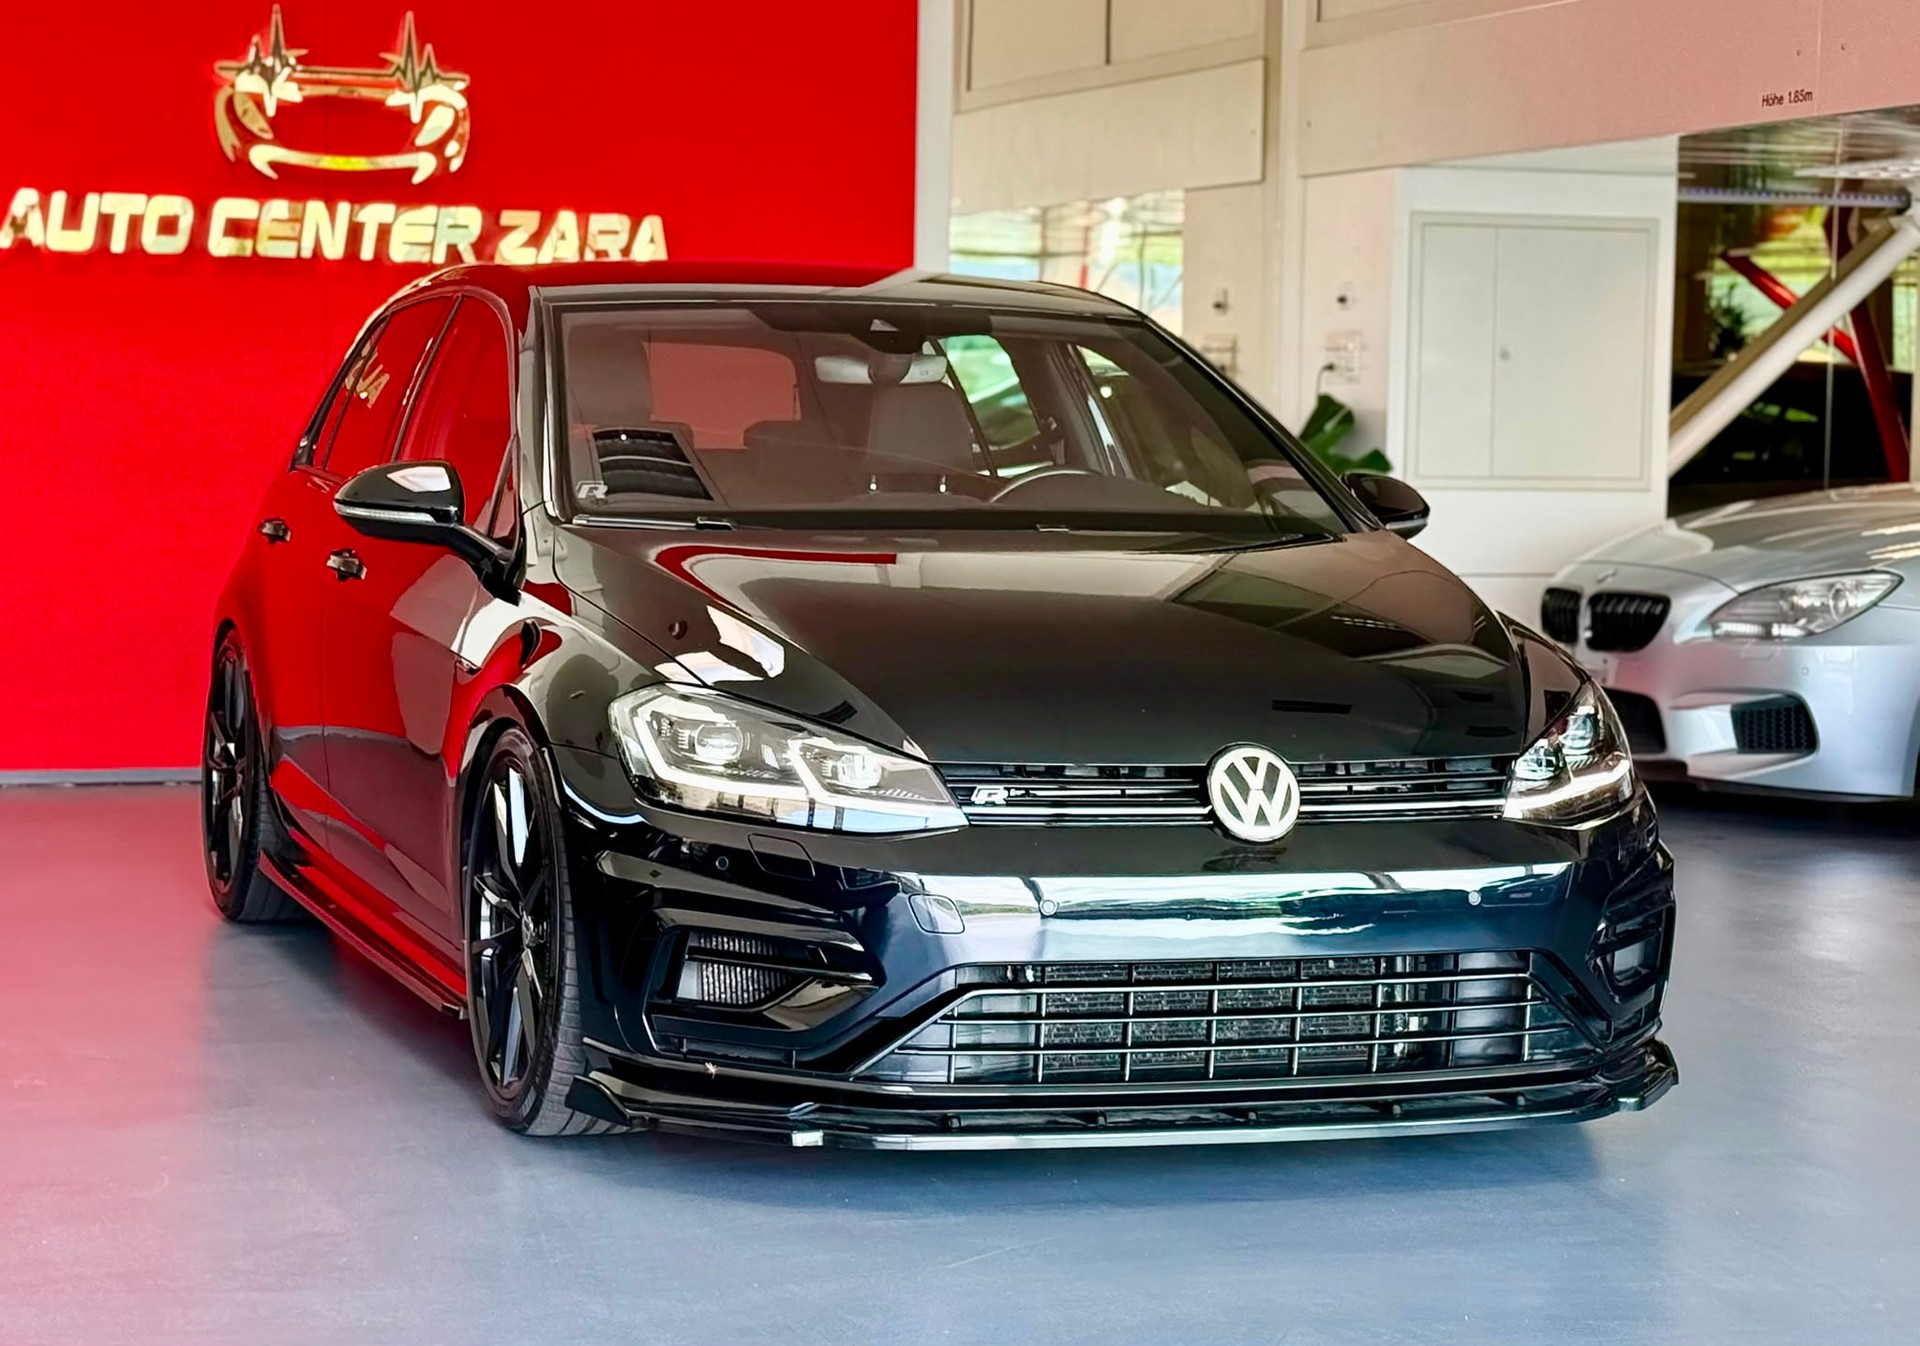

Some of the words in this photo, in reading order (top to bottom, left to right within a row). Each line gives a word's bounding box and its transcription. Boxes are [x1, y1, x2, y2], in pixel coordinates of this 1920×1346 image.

[1761, 93, 1784, 107] Höhe
[1788, 88, 1813, 104] 1.85m
[0, 187, 194, 255] AUTO
[207, 197, 483, 264] CENTER
[494, 209, 669, 265] ZARA
[576, 480, 608, 499] R
[971, 786, 1009, 805] R
[1207, 747, 1300, 842] VW
